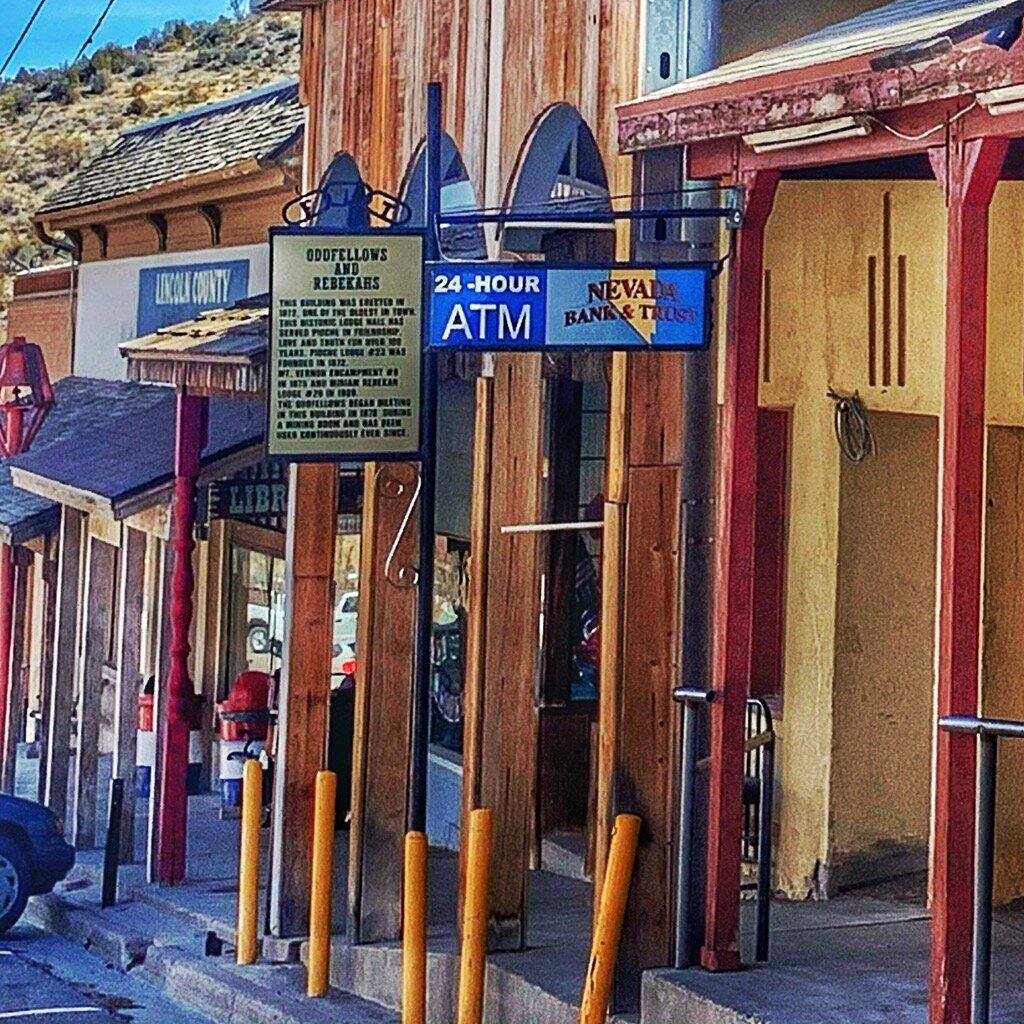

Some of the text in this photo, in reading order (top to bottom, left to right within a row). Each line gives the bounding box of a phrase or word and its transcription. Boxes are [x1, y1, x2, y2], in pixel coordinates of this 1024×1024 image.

[306, 248, 388, 262] ODDFELLOWS
[334, 262, 359, 276] AND
[192, 268, 231, 305] COUNTY
[313, 276, 380, 291] REBEKAHS
[588, 279, 677, 303] NEVADA
[300, 297, 336, 307] BUILDING
[339, 297, 356, 307] WAS
[332, 308, 346, 317] THE
[563, 304, 696, 327] BANK & TRUST
[441, 304, 531, 340] ATM
[301, 338, 317, 347] AND
[388, 347, 406, 357] WAS
[277, 419, 283, 429] A
[229, 483, 287, 514] LIBR
